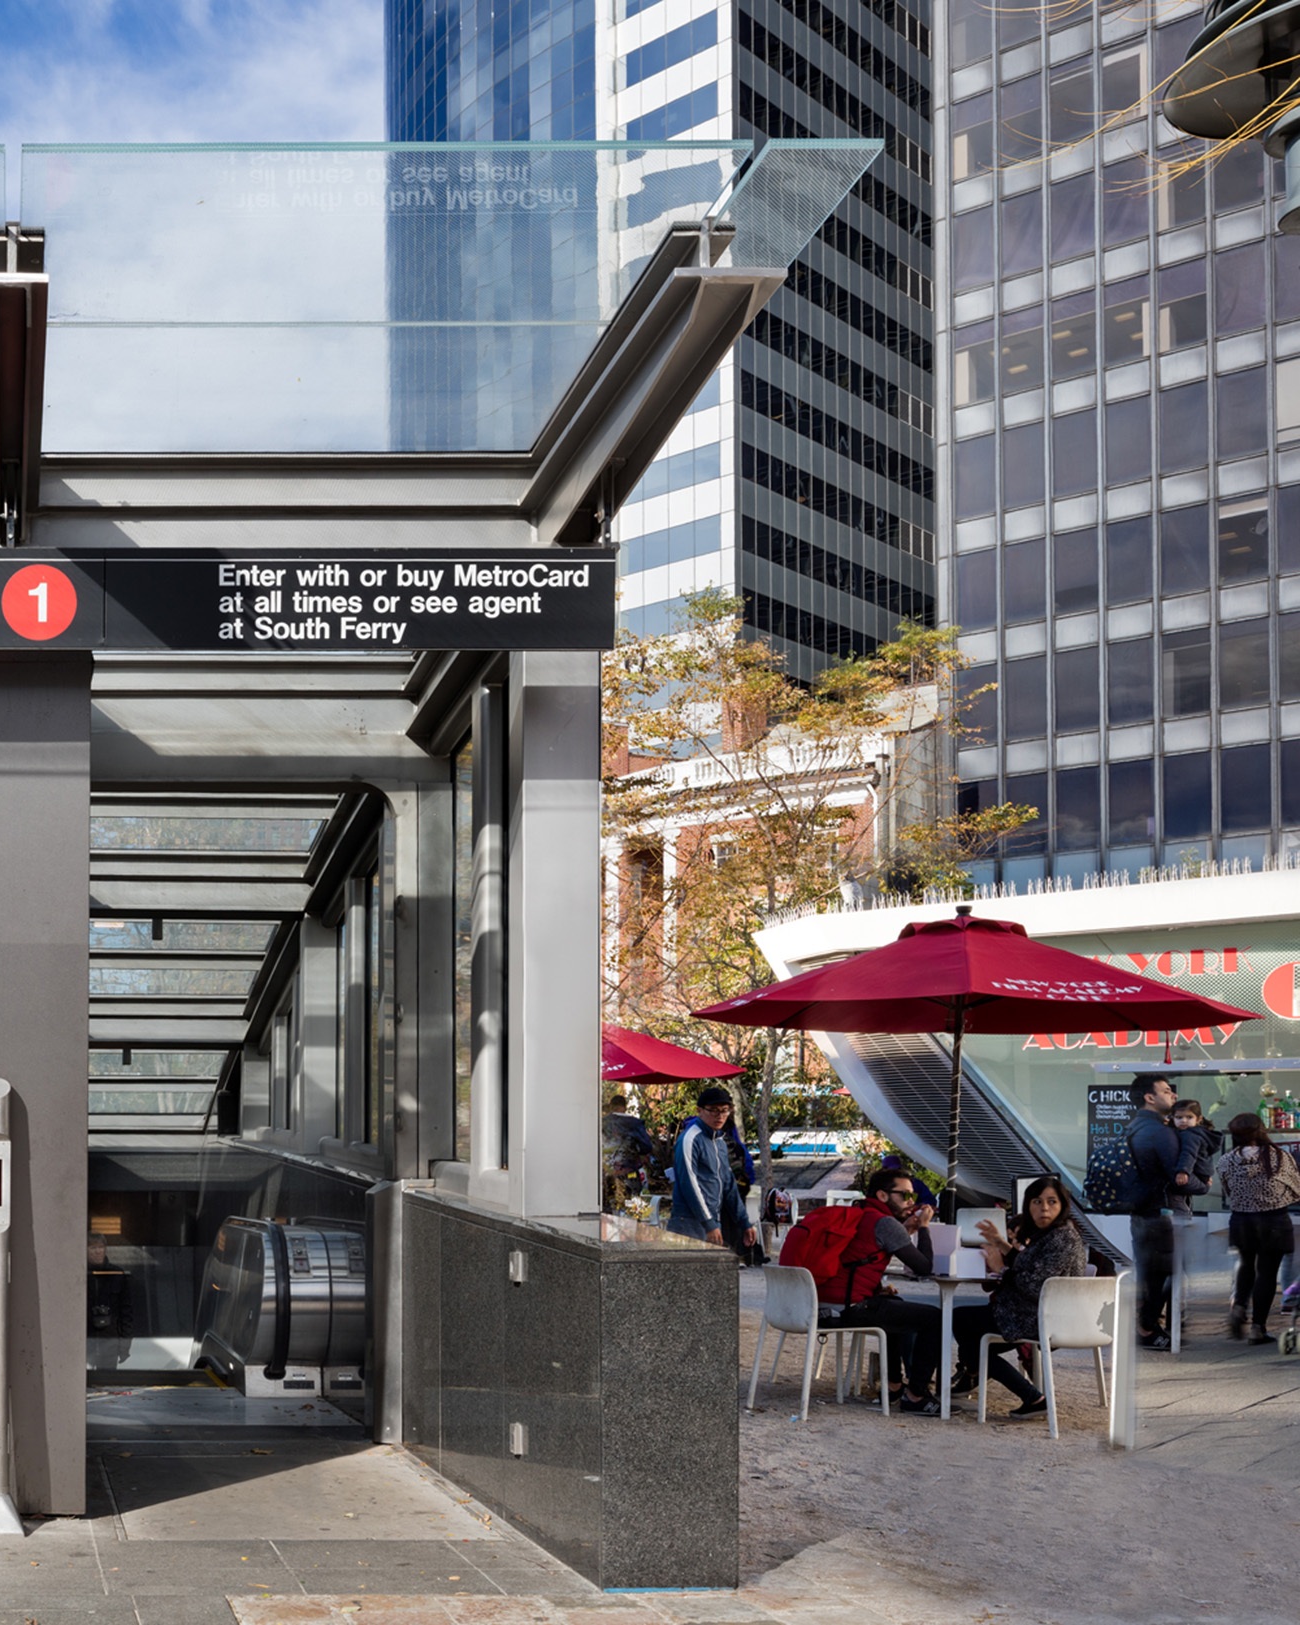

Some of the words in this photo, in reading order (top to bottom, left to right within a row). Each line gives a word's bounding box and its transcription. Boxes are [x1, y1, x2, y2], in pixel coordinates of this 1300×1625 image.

[218, 564, 287, 588] Enter
[295, 563, 350, 588] with
[359, 568, 388, 588] or
[396, 563, 445, 593] buy
[453, 563, 590, 588] MetroCard
[27, 582, 48, 623] 1
[218, 592, 244, 614] at
[253, 590, 283, 614] all
[291, 590, 363, 614] times
[372, 595, 401, 614] or
[410, 595, 459, 614] see
[467, 592, 542, 620] agent
[218, 617, 244, 640] at
[253, 615, 331, 641] South
[340, 616, 408, 645] Ferry
[1126, 945, 1255, 978] YORK
